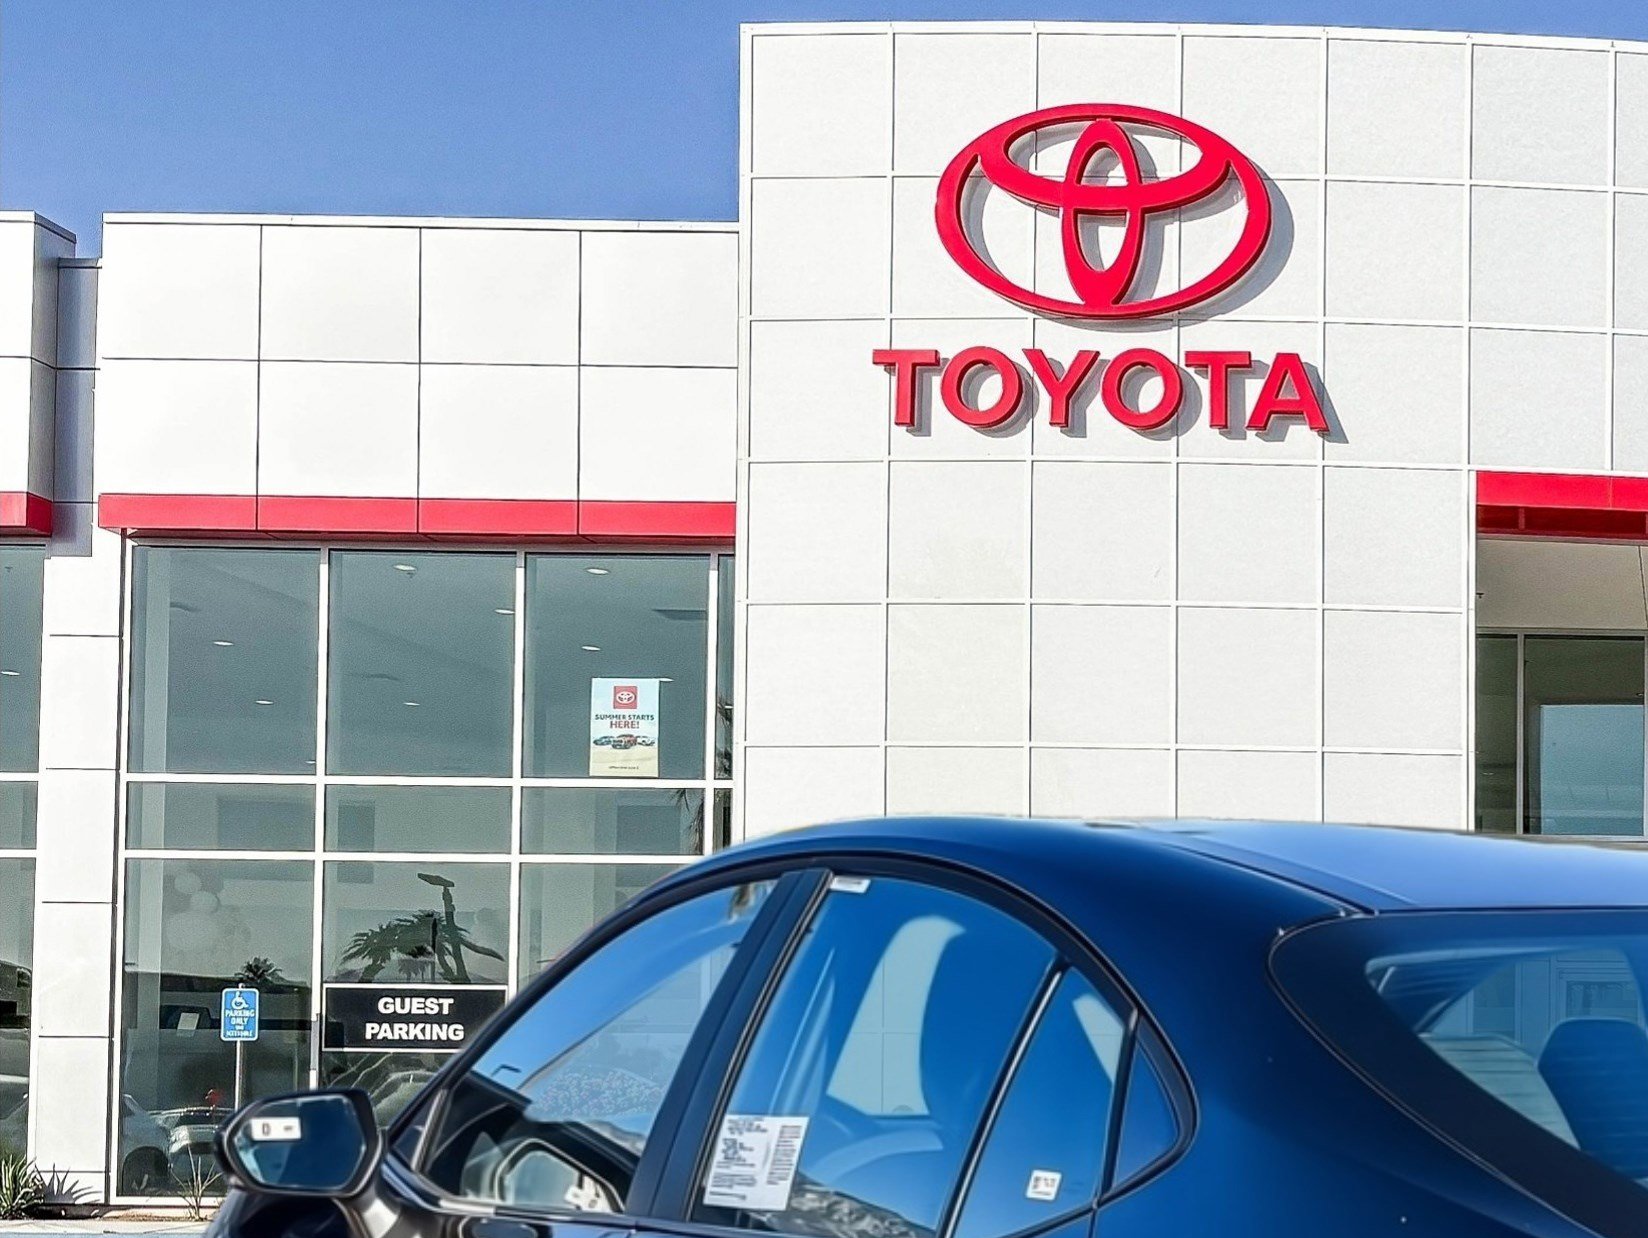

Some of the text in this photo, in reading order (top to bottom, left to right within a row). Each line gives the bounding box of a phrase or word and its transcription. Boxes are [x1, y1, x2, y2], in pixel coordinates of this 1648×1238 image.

[872, 345, 1330, 433] TOYOTA
[610, 721, 640, 729] HERE!
[377, 996, 454, 1015] GUEST
[365, 1022, 465, 1041] PARKING
